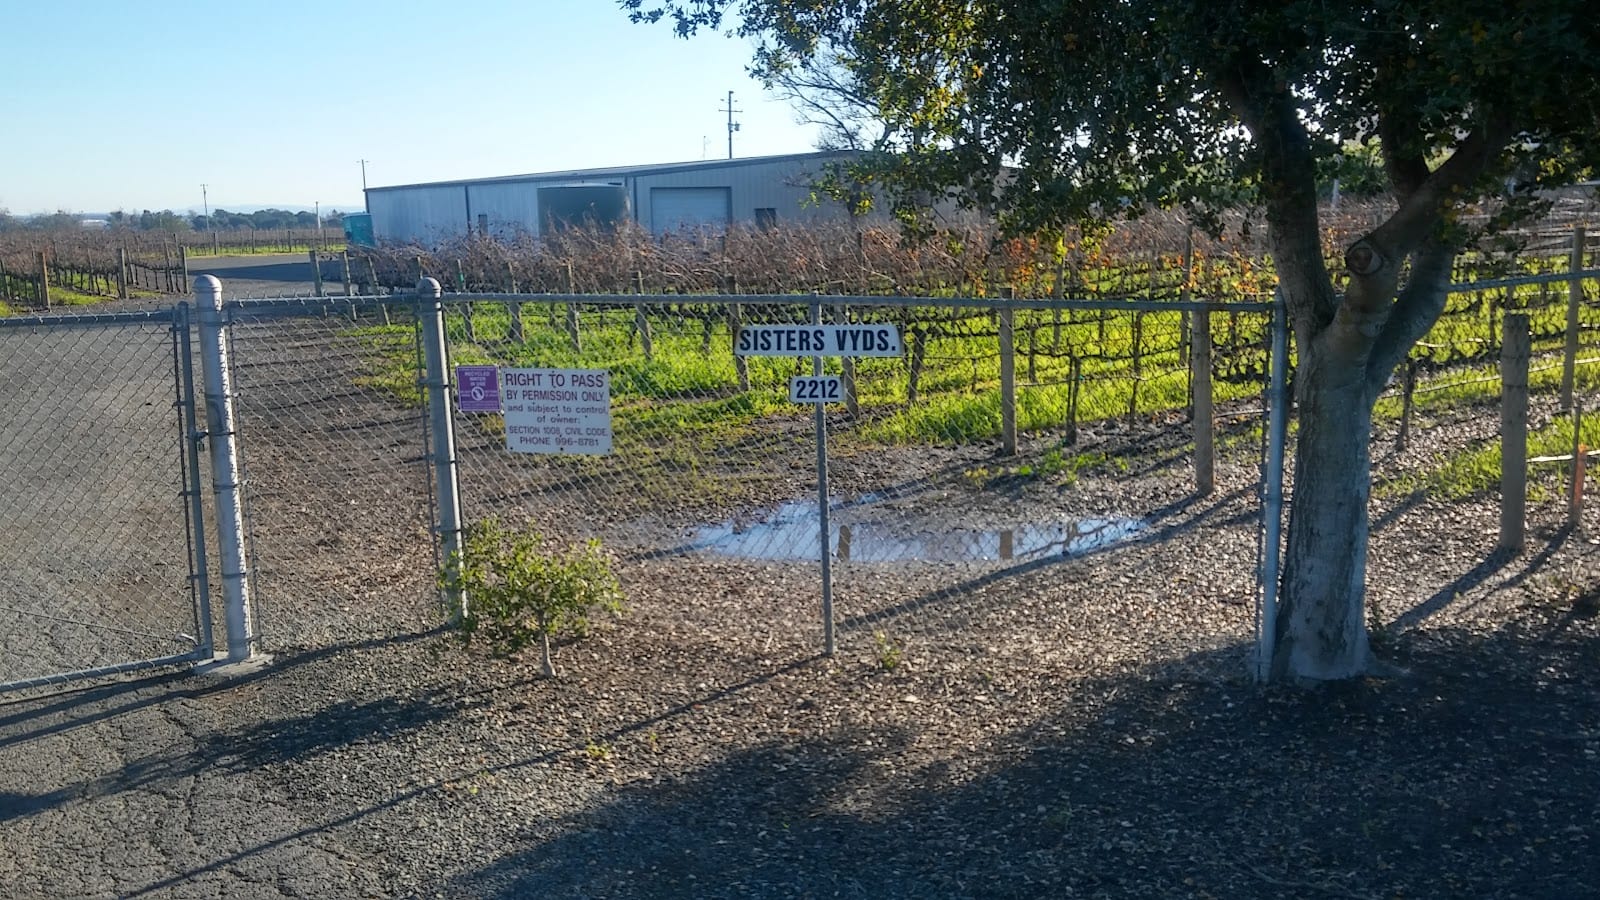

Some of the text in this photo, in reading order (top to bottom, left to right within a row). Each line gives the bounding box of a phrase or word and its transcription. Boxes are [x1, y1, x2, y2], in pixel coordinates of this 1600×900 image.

[739, 329, 897, 352] SISTERS VYDS.
[505, 373, 604, 388] RIGHT TO PASS
[796, 379, 839, 399] 2212
[506, 389, 517, 400] BY
[522, 390, 578, 401] PERMISSION
[508, 404, 523, 412] and
[527, 404, 559, 415] subject
[563, 405, 572, 413] to
[536, 415, 546, 424] of
[509, 426, 540, 435] SECTION
[565, 427, 582, 436] CIVIL
[519, 436, 599, 447] PHONE 996-8781
